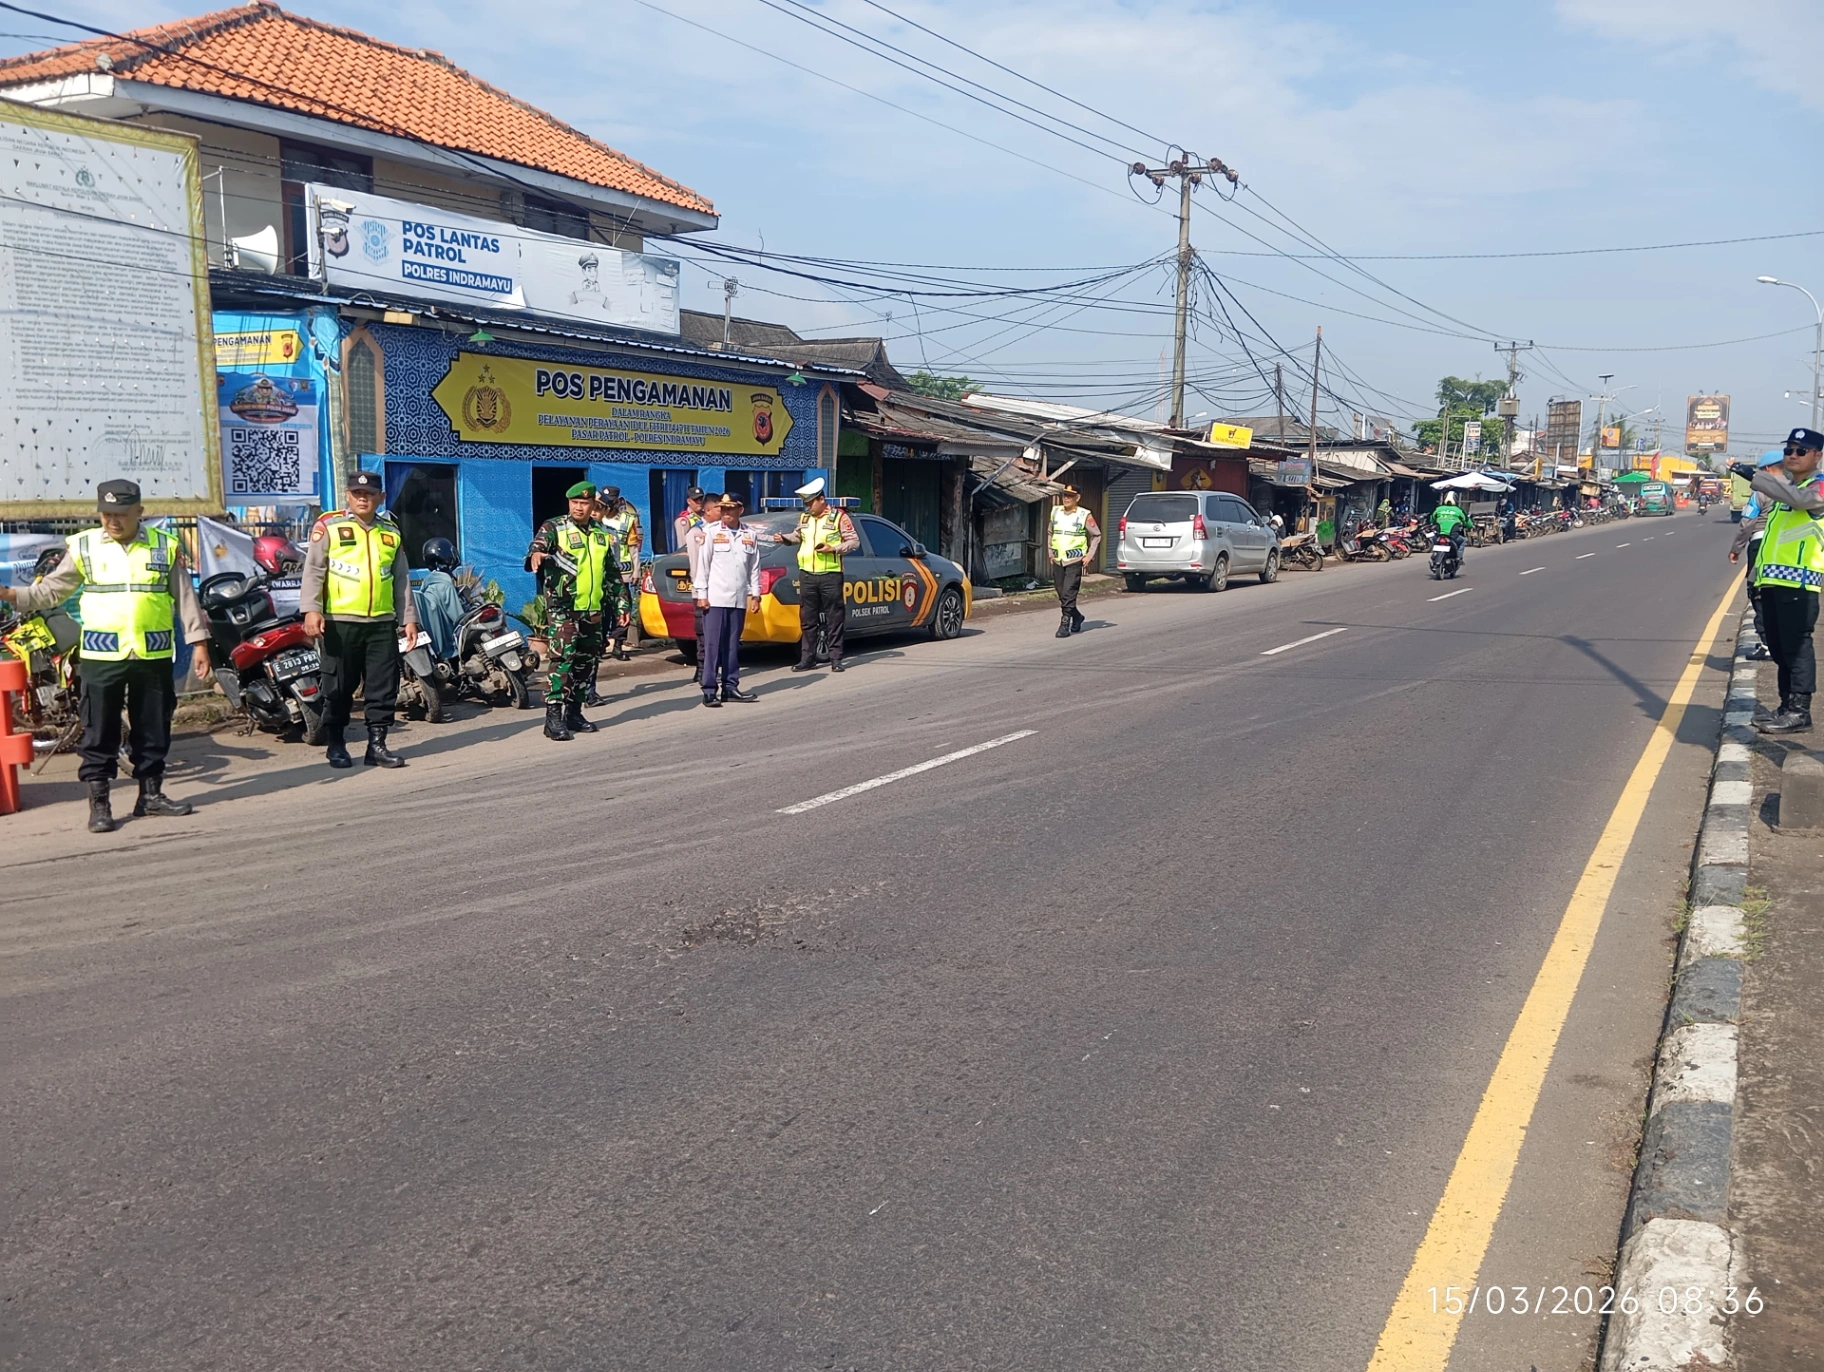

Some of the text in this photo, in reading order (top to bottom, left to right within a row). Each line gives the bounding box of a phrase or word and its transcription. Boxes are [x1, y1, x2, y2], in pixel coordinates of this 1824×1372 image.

[402, 221, 500, 253] POS LANTAS
[403, 238, 466, 264] PATROL
[404, 263, 511, 292] POLRES INDRAMAYU
[535, 369, 732, 412] POS PENGAMANAN
[538, 414, 588, 428] PELAYANAN
[588, 418, 629, 430] PERAYAAN
[630, 420, 648, 431] IDUL
[690, 425, 714, 436] TAHUN
[715, 426, 731, 437] 2026
[611, 407, 672, 421] DALAM RANGKA
[571, 429, 599, 441] PASAR
[599, 431, 630, 442] PATROL
[634, 432, 663, 444] POLRES
[663, 434, 705, 446] INDRAMAYU
[842, 580, 901, 605] POLISI
[852, 605, 890, 618] POLSEK PATROL
[275, 664, 282, 672] E
